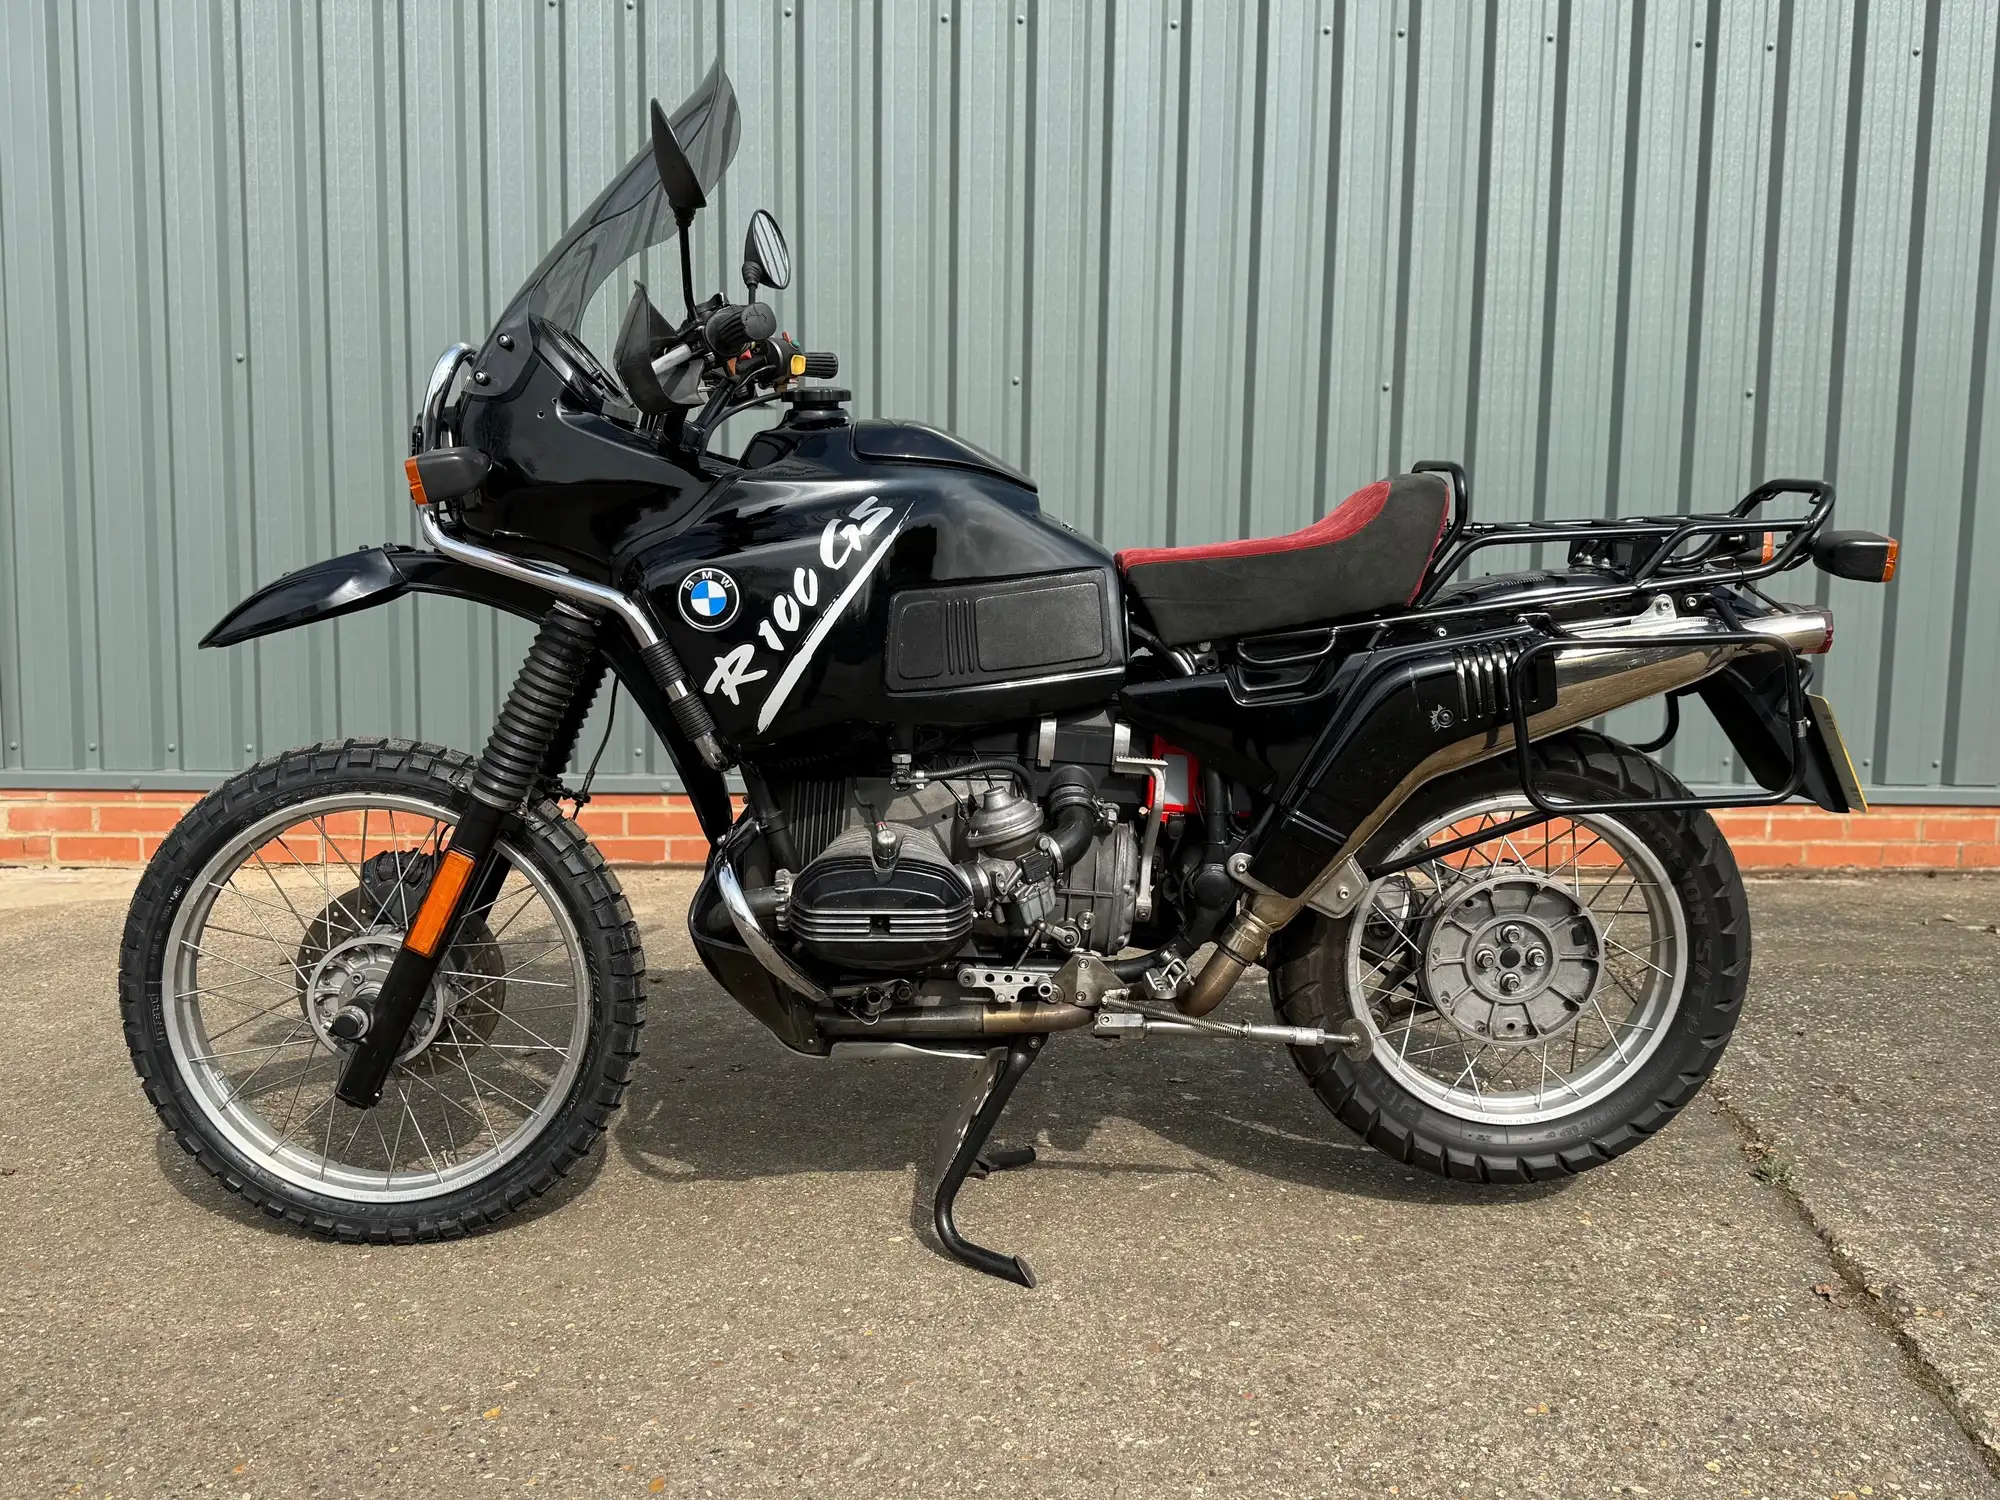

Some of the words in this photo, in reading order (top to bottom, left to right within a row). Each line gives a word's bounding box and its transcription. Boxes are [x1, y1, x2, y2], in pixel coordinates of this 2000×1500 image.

[684, 571, 733, 591] BMW
[704, 644, 768, 706] R
[758, 567, 819, 650] 100
[820, 496, 894, 570] GS
[1588, 788, 1709, 926] SORPION
